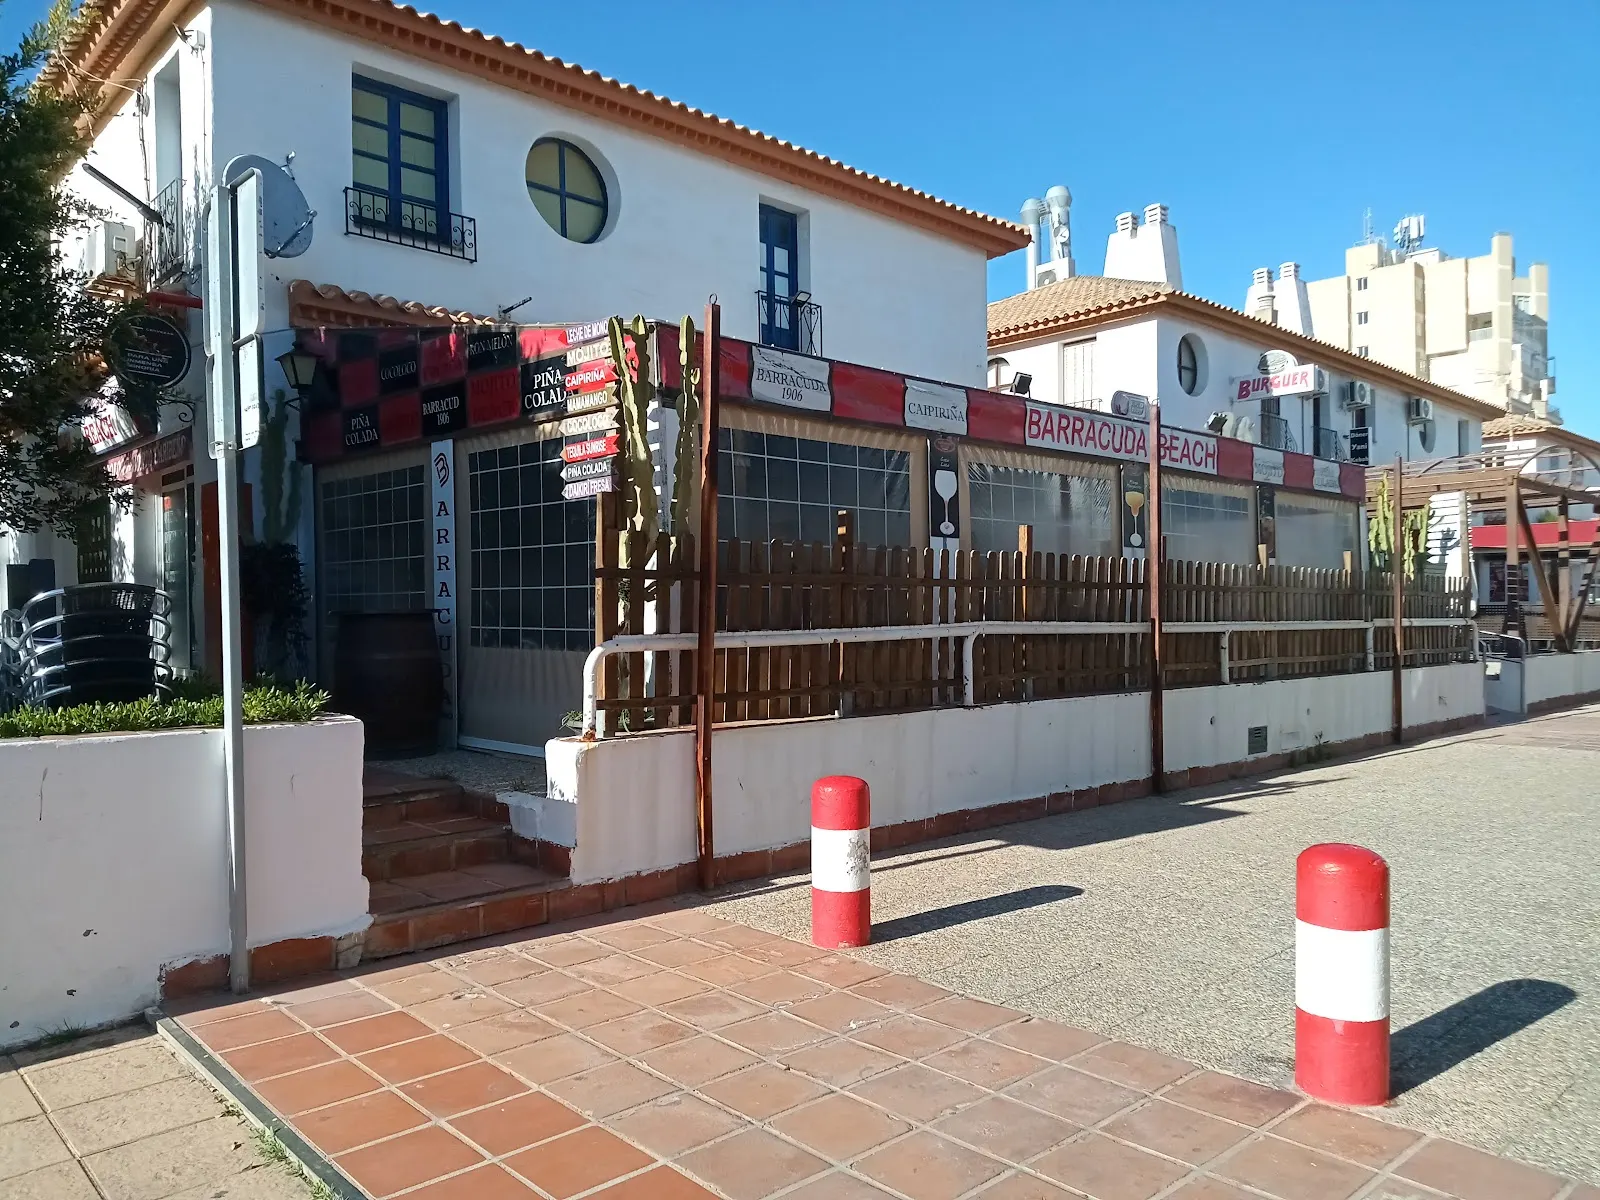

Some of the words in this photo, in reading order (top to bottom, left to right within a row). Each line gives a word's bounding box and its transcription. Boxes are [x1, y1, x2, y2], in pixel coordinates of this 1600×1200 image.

[567, 324, 583, 343] LECHE
[583, 322, 592, 338] DE
[591, 319, 609, 337] MONO
[486, 333, 514, 352] MELÓN
[127, 352, 150, 361] PARA
[567, 342, 608, 366] MOJITO
[380, 360, 417, 382] COCOLOCO
[533, 366, 562, 389] PIÑA
[565, 368, 606, 388] CAIPIRIÑA
[756, 367, 827, 393] BARRACUDA
[781, 386, 803, 402] 1906
[1237, 370, 1309, 400] BURGUER
[351, 413, 372, 431] PIÑA
[437, 412, 450, 426] 1906
[908, 402, 966, 423] CAIPIRIÑA
[83, 414, 118, 445] BEACH
[567, 414, 609, 434] COCOLOCO
[345, 428, 377, 447] COLADA
[1027, 408, 1148, 459] BARRACUDA
[1158, 431, 1217, 473] BEACH
[1351, 443, 1368, 451] Yani
[566, 442, 585, 459] TEQUILA
[585, 439, 606, 455] SUNRISE
[567, 464, 582, 478] PIÑA
[582, 460, 608, 476] COLADA
[591, 478, 610, 494] FRESA
